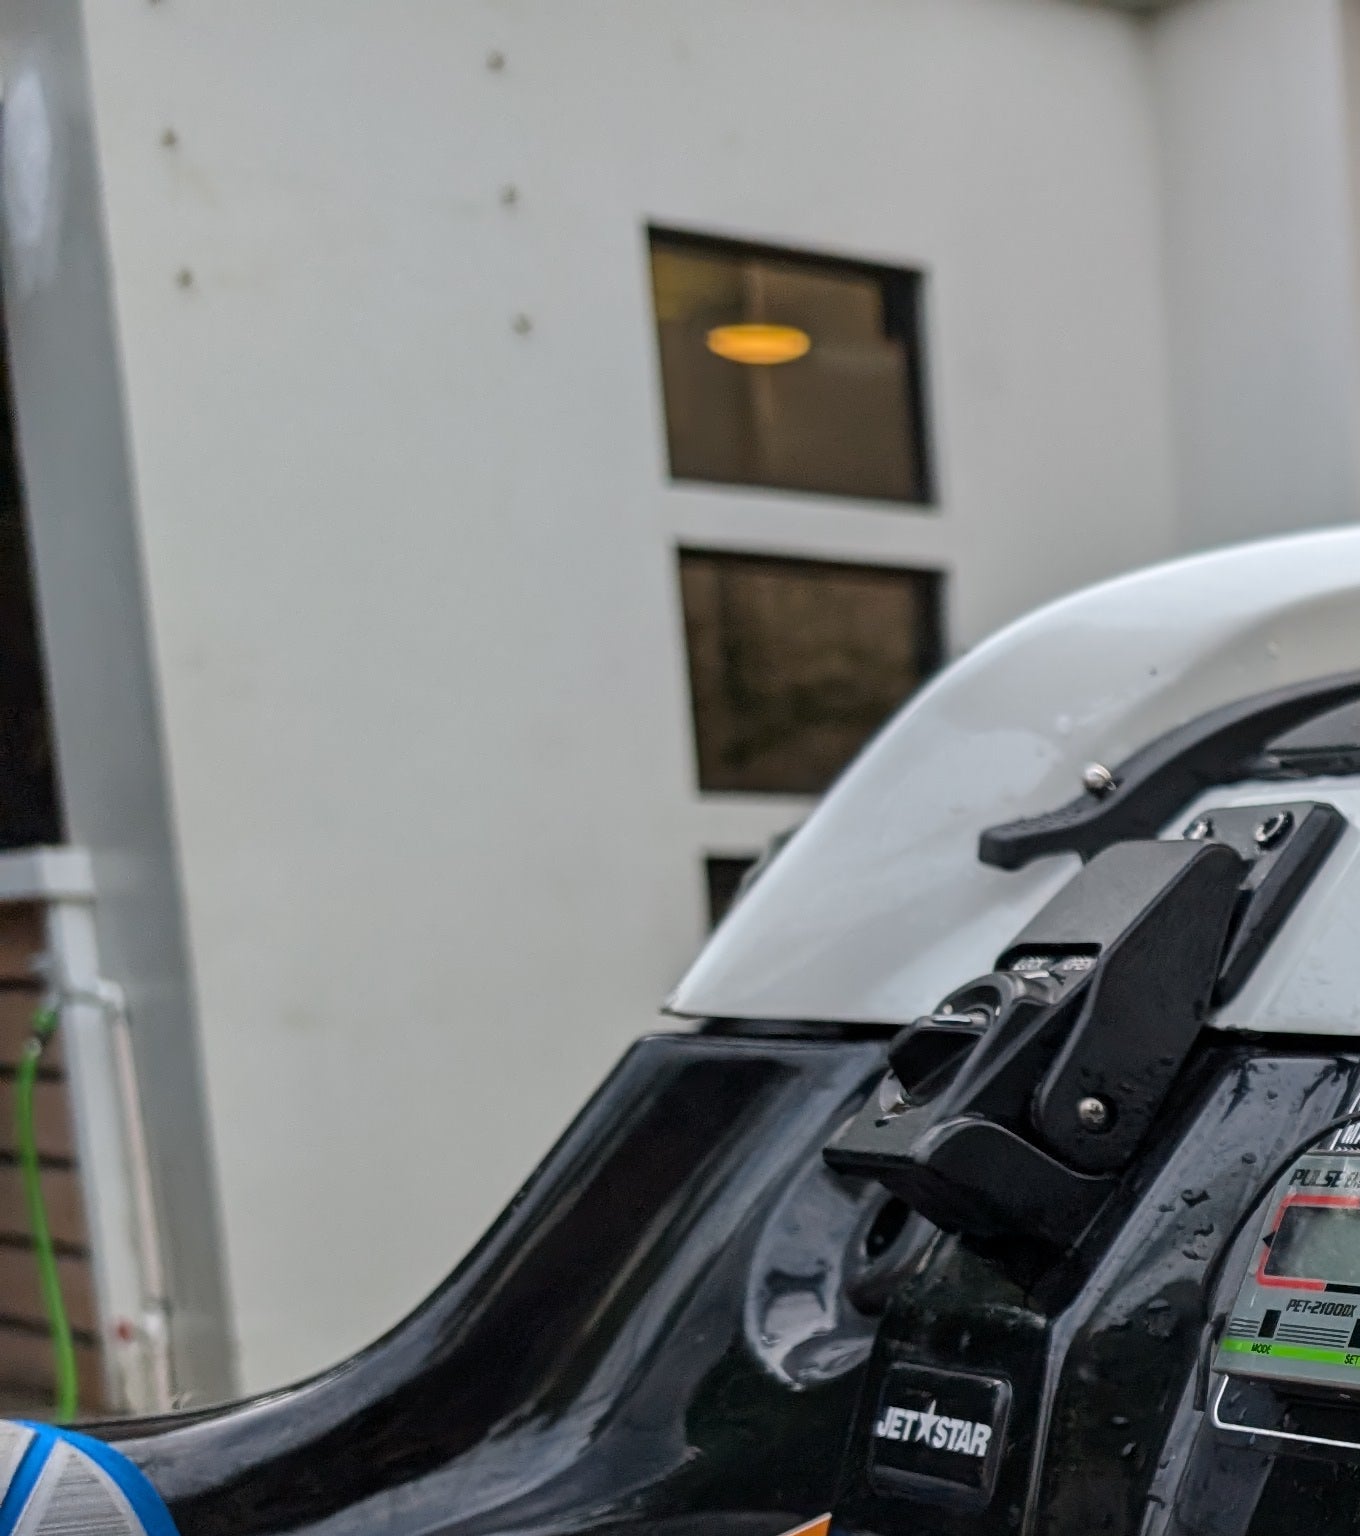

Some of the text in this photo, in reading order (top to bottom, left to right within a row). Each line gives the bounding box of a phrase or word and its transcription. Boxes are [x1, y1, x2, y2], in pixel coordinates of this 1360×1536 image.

[1288, 1168, 1344, 1188] PULSE
[1251, 1342, 1360, 1366] MODE SET
[876, 1404, 993, 1458] JET STAR
